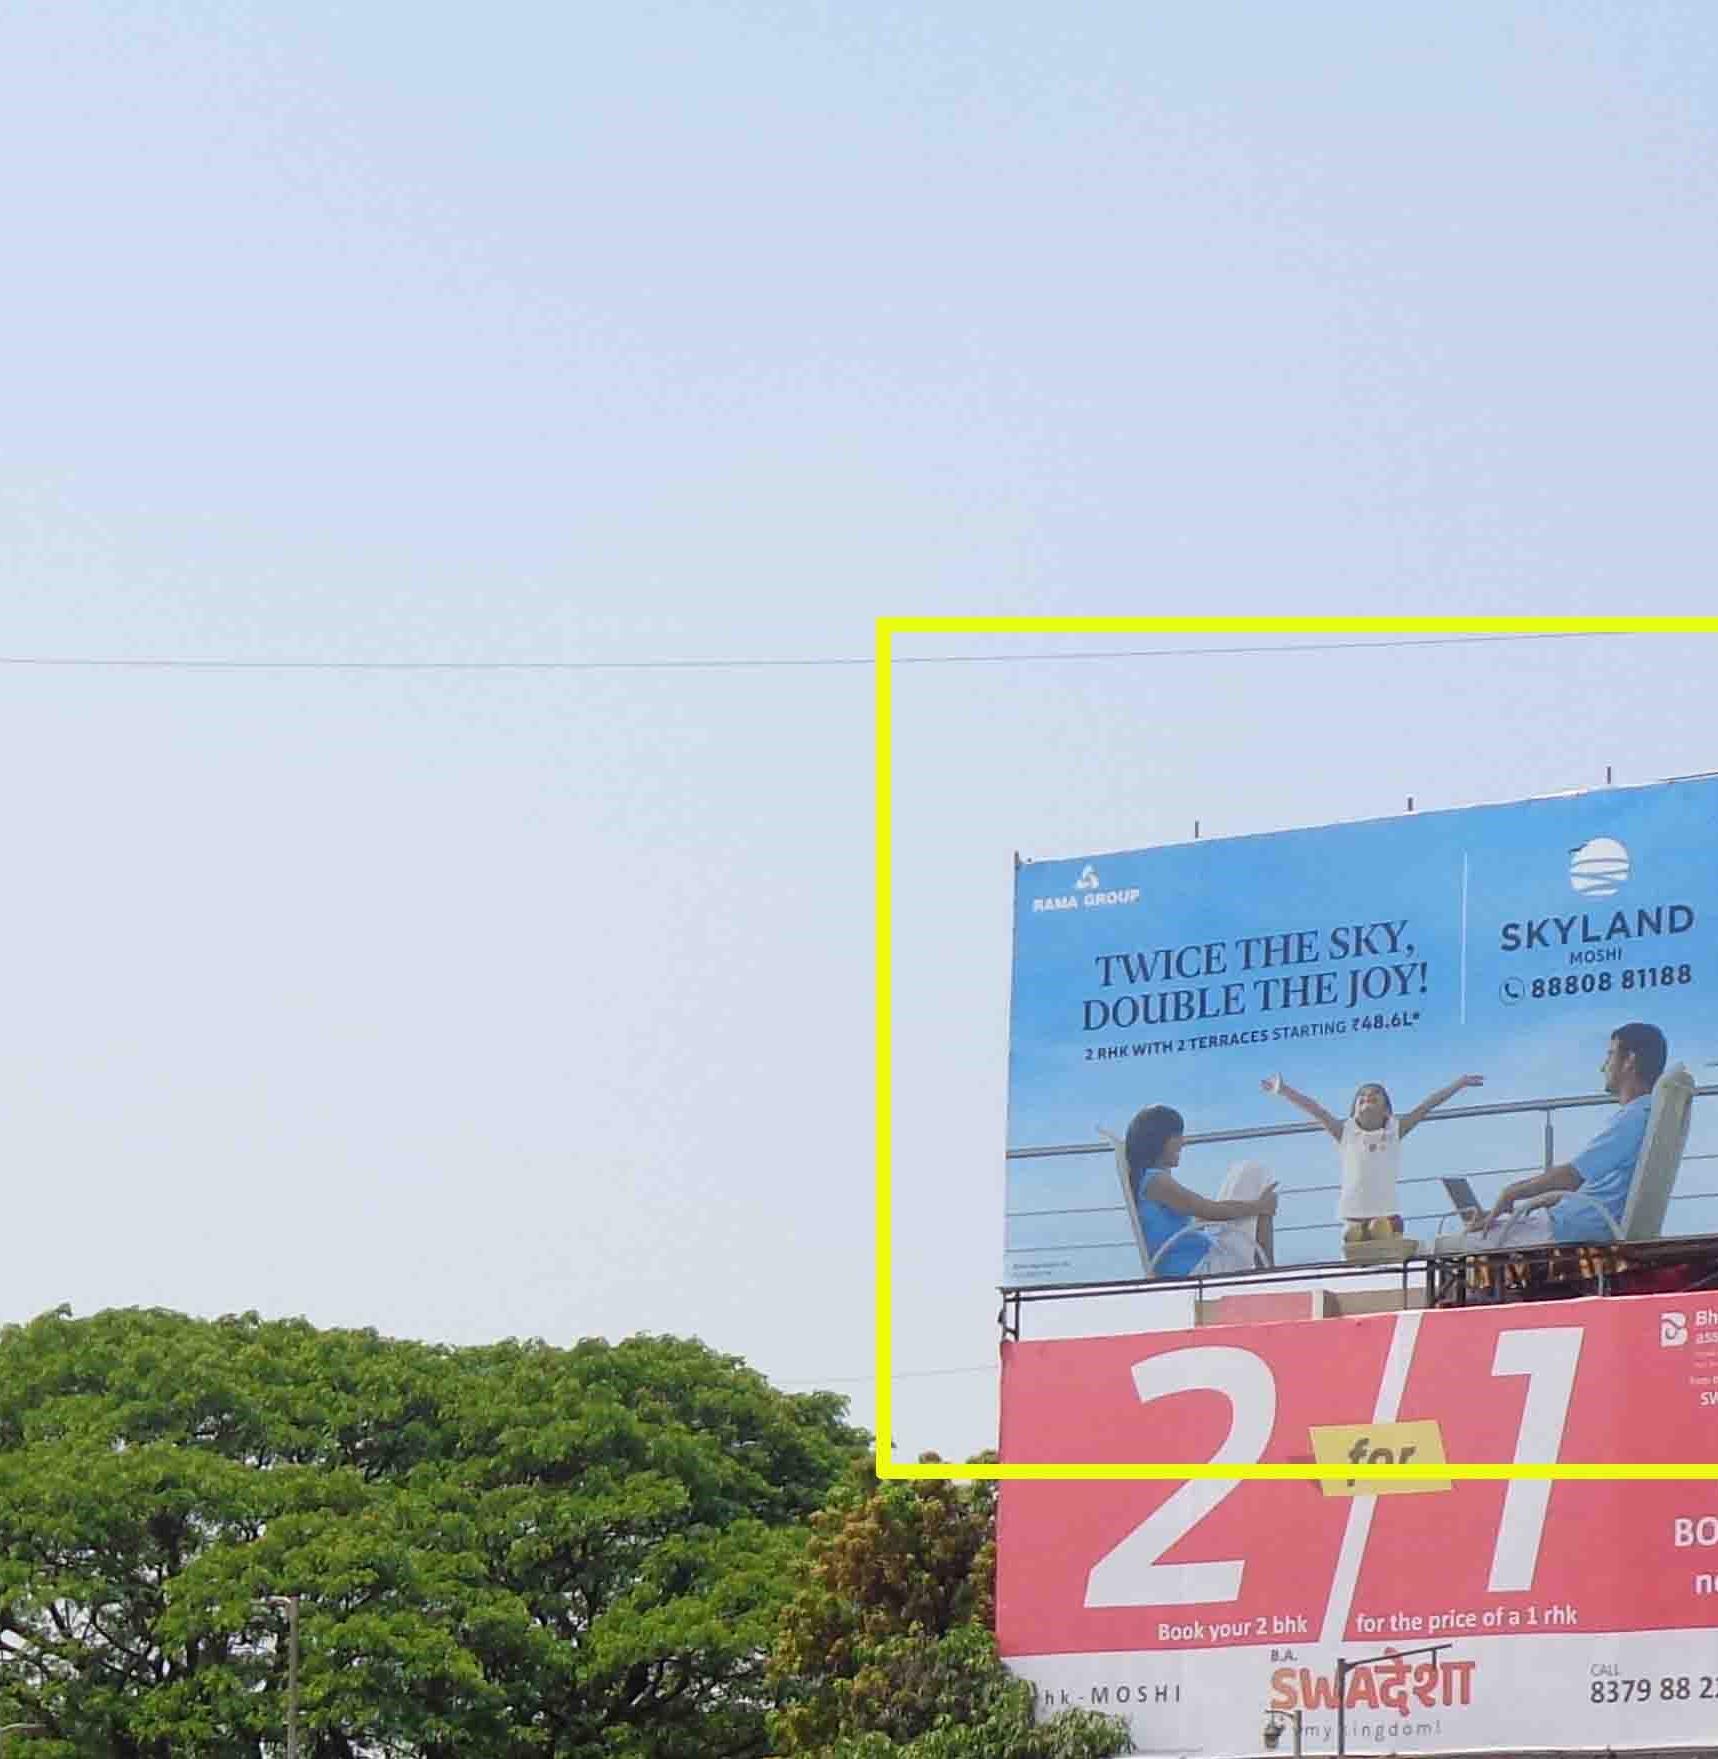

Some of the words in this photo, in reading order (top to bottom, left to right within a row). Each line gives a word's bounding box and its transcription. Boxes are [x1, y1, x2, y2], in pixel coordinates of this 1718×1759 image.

[1032, 895, 1079, 912] RAMA
[1084, 888, 1140, 907] GROUP
[1500, 903, 1695, 952] SKYLAND
[1095, 941, 1227, 988] TWICE
[1235, 929, 1320, 971] THE
[1328, 919, 1416, 961] SKY,
[1569, 947, 1623, 965] MOSHI
[1083, 982, 1246, 1032] DOUBLE
[1253, 971, 1338, 1012] THE
[1344, 960, 1428, 1009] JOY!
[1531, 971, 1612, 999] 88808
[1621, 963, 1692, 990] 81188
[1085, 1048, 1095, 1061] 2
[1131, 1041, 1173, 1057] WITH
[1177, 1039, 1185, 1052] 2
[1189, 1030, 1268, 1051] TERRACES
[1271, 1020, 1347, 1042] STARTING
[1083, 1345, 1277, 1609] 2
[1485, 1325, 1584, 1592] 1
[1158, 1623, 1204, 1641] Book
[1209, 1620, 1251, 1641] your
[1256, 1617, 1269, 1635] 2
[1273, 1616, 1308, 1635] bhk
[1356, 1613, 1387, 1634] for
[1391, 1611, 1424, 1632] the
[1429, 1608, 1476, 1632] price
[1483, 1605, 1506, 1626] of
[1509, 1610, 1520, 1625] a
[1526, 1605, 1538, 1625] 1
[1544, 1604, 1578, 1625] rhk
[1590, 1663, 1620, 1677] CALL
[1091, 1684, 1180, 1705] MOSHI
[1590, 1678, 1652, 1704] 8379
[1660, 1676, 1691, 1701] 88
[1344, 1720, 1443, 1742] ingdom!
